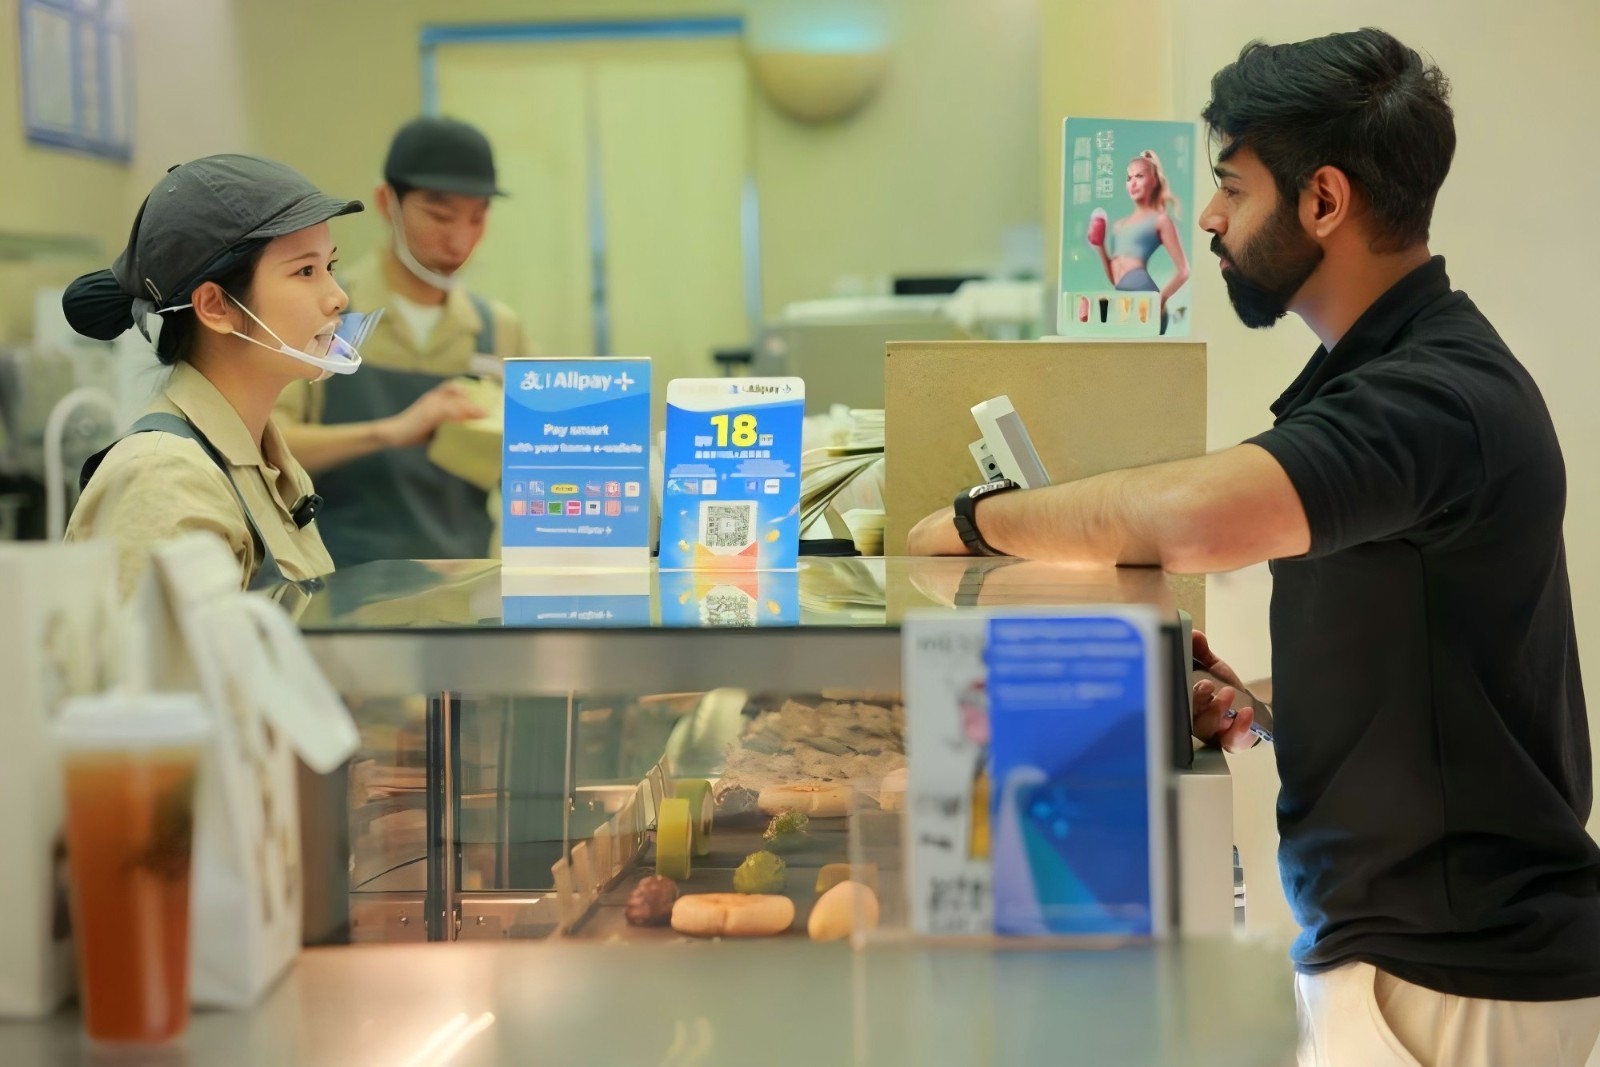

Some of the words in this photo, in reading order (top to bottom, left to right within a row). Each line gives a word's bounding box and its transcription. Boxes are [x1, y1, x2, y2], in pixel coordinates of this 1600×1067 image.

[543, 423, 569, 438] Pay
[569, 424, 609, 436] smart
[710, 413, 758, 447] 18
